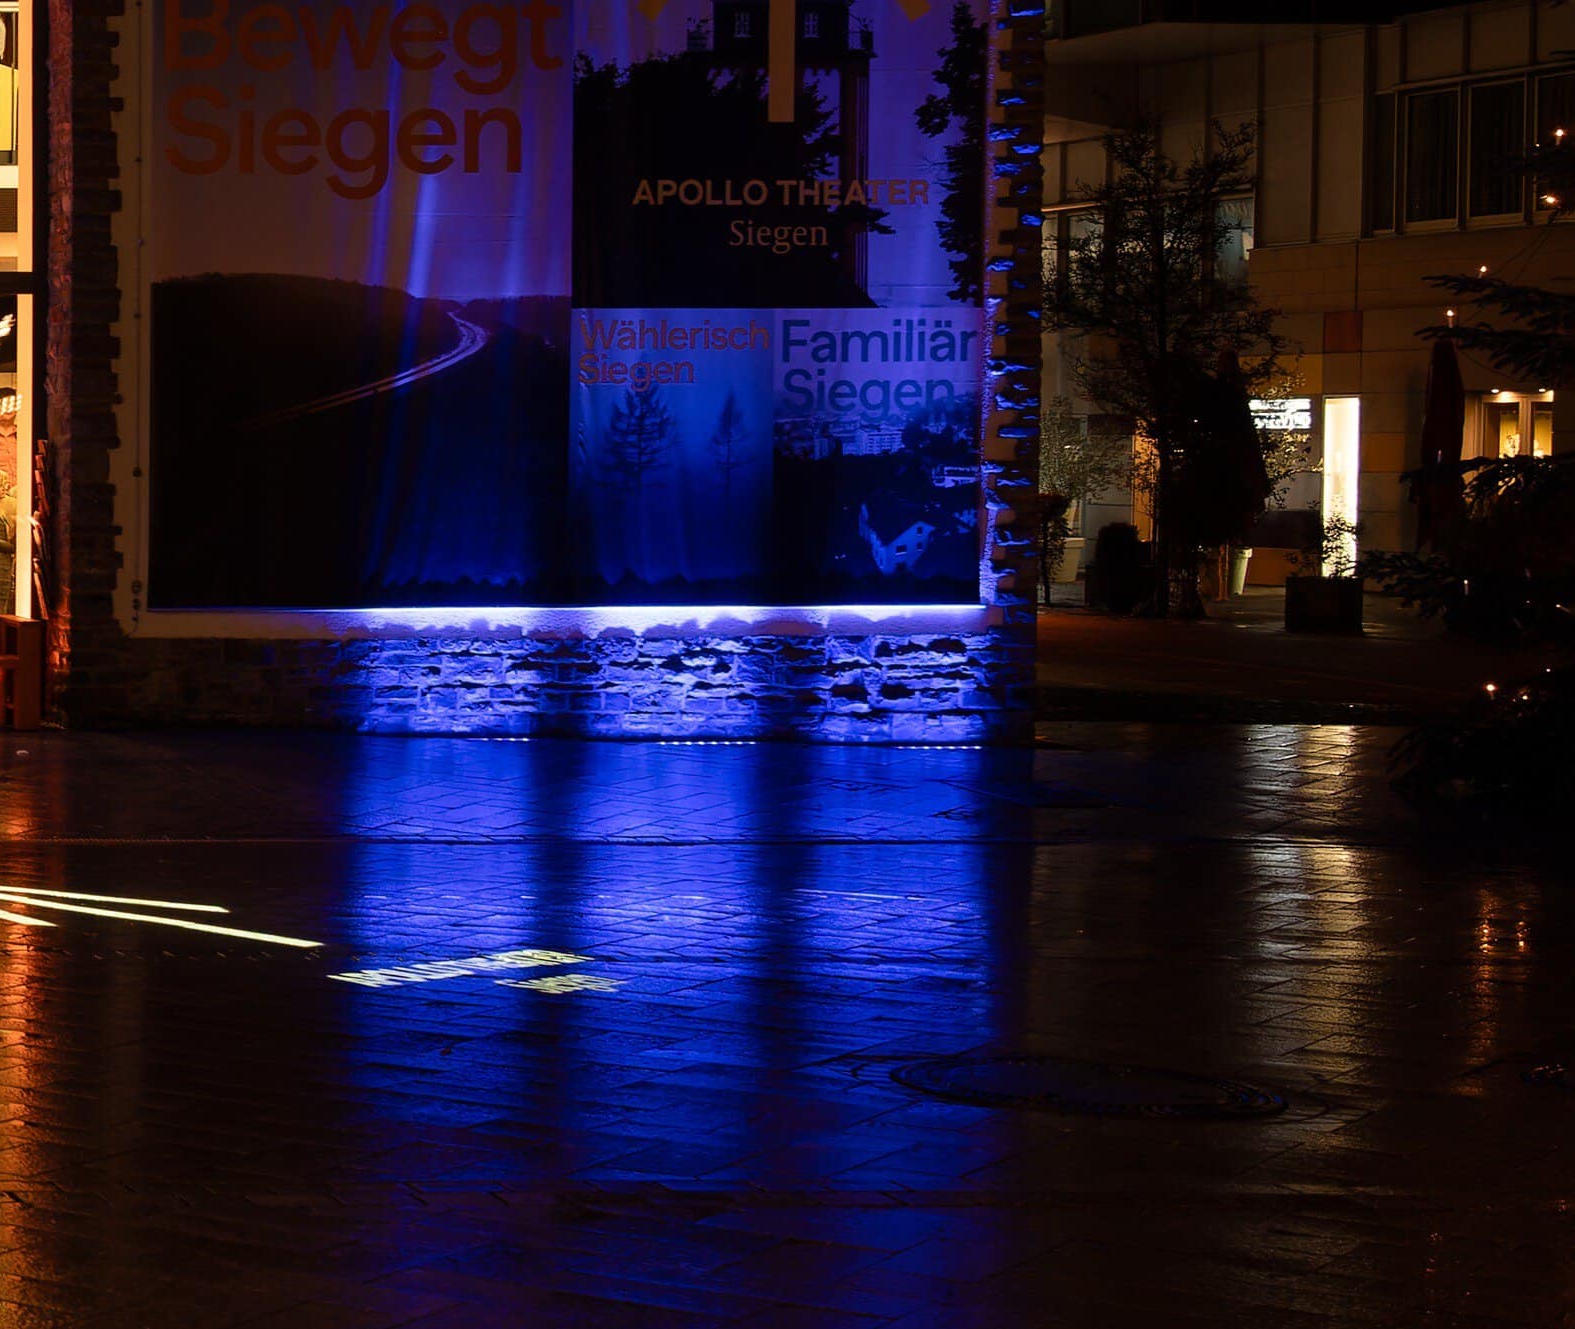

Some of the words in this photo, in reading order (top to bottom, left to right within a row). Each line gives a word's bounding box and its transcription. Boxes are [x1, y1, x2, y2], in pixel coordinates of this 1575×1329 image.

[166, 85, 522, 200] Siegen
[632, 179, 768, 208] APOLLO
[776, 179, 930, 208] THEATER
[729, 219, 829, 252] Siegen
[579, 319, 770, 351] Wählerisch
[783, 319, 978, 363] Familiär
[579, 354, 694, 392] Siegen
[784, 369, 953, 423] Siegen
